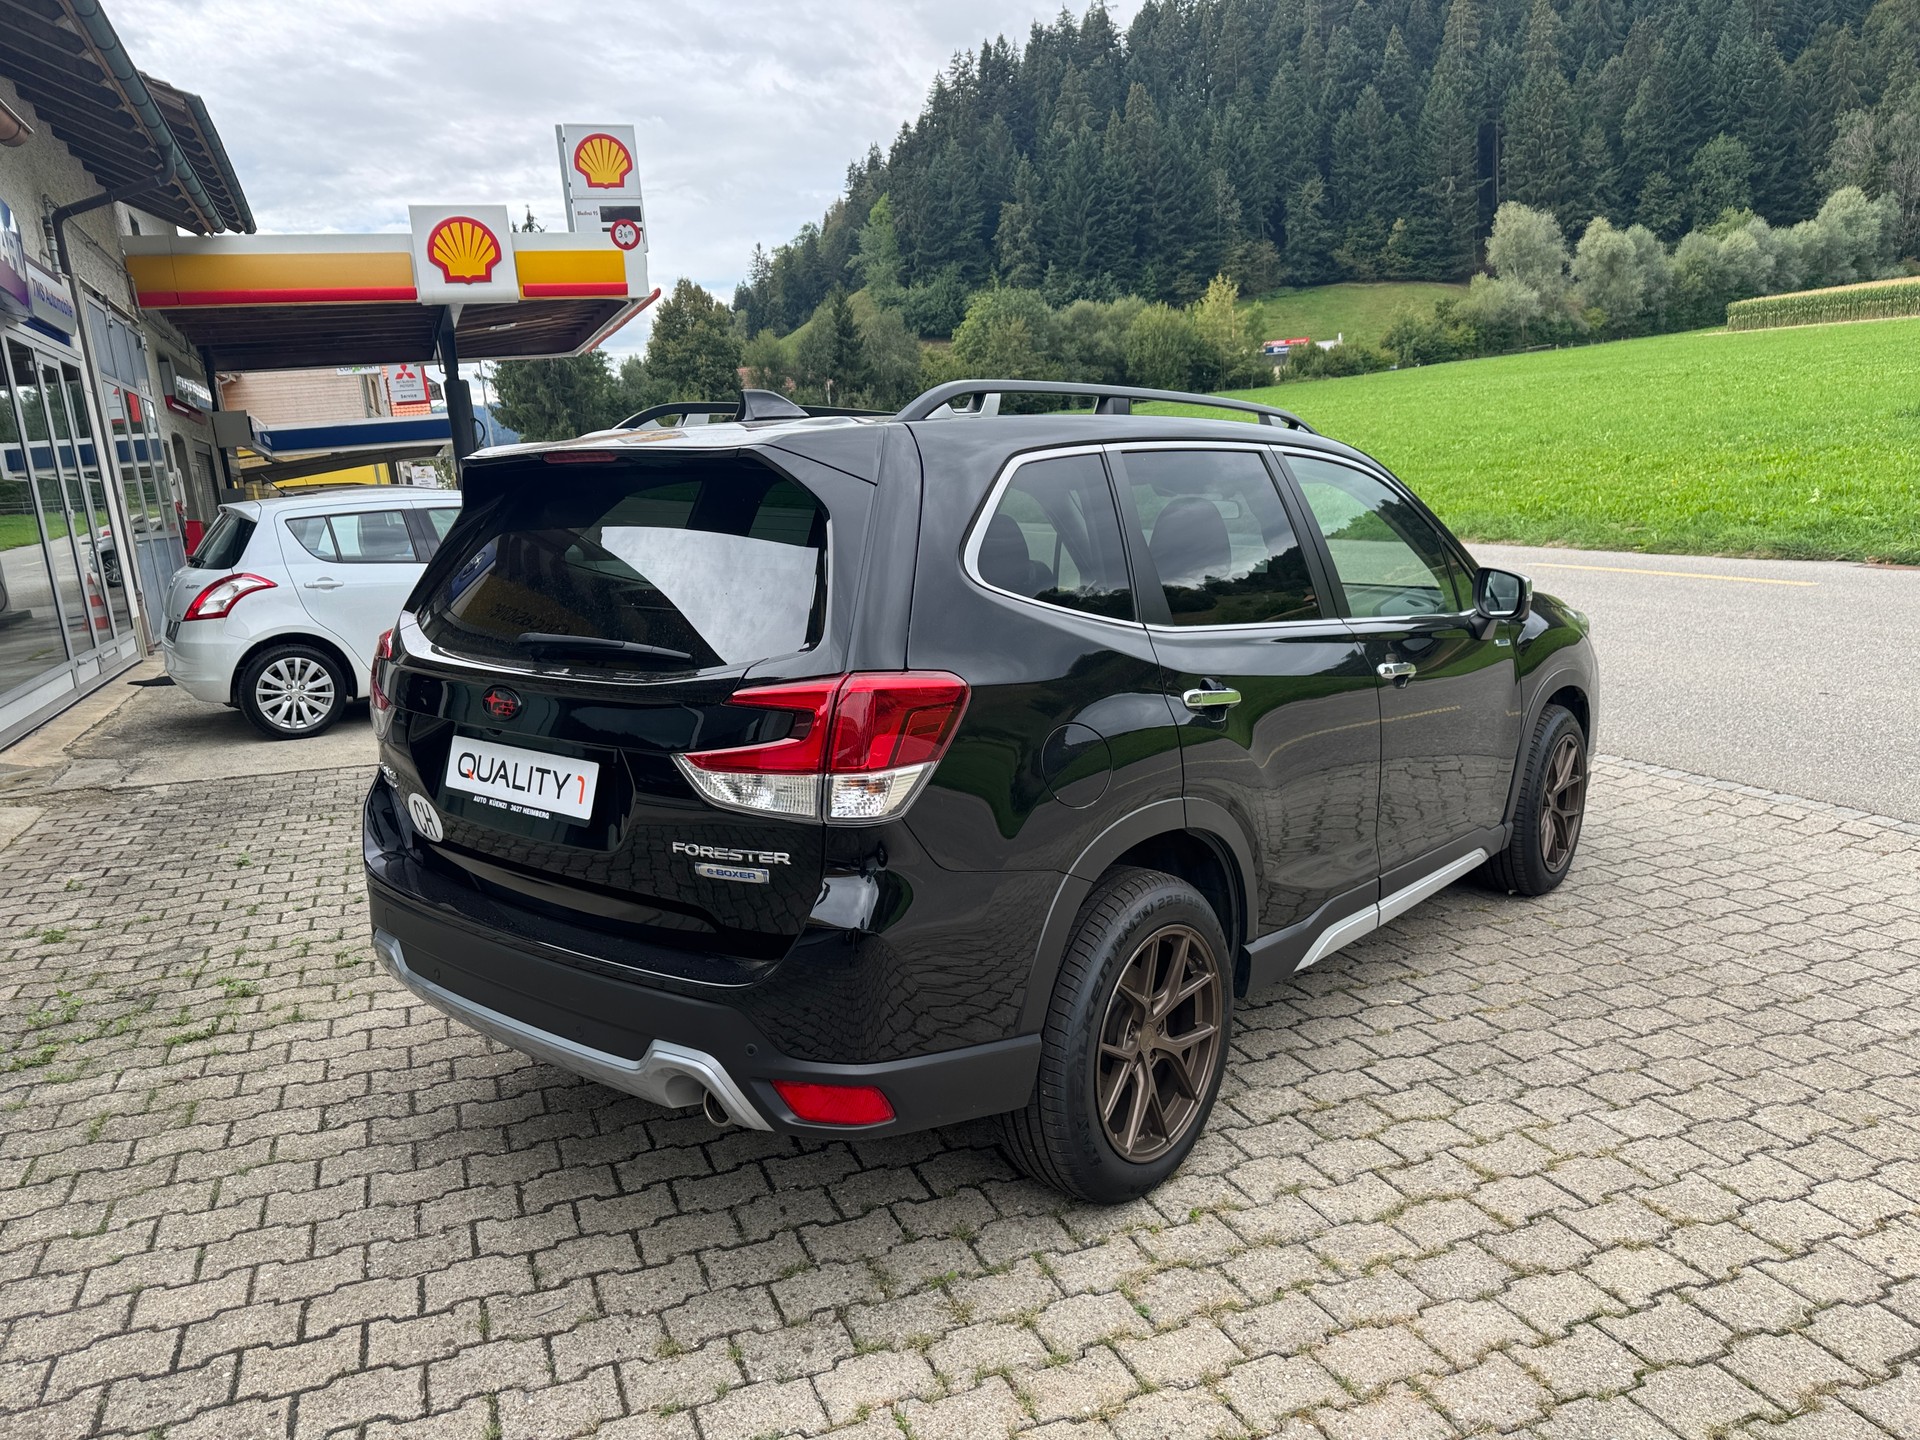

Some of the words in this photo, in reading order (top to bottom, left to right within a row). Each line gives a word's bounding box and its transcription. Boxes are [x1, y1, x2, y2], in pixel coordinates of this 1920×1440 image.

[458, 752, 571, 799] QUALITY
[413, 800, 439, 838] CH
[473, 795, 487, 804] AUTO
[510, 804, 522, 812] 3627
[522, 807, 550, 819] HEIMBERG
[672, 841, 792, 865] FORESTER
